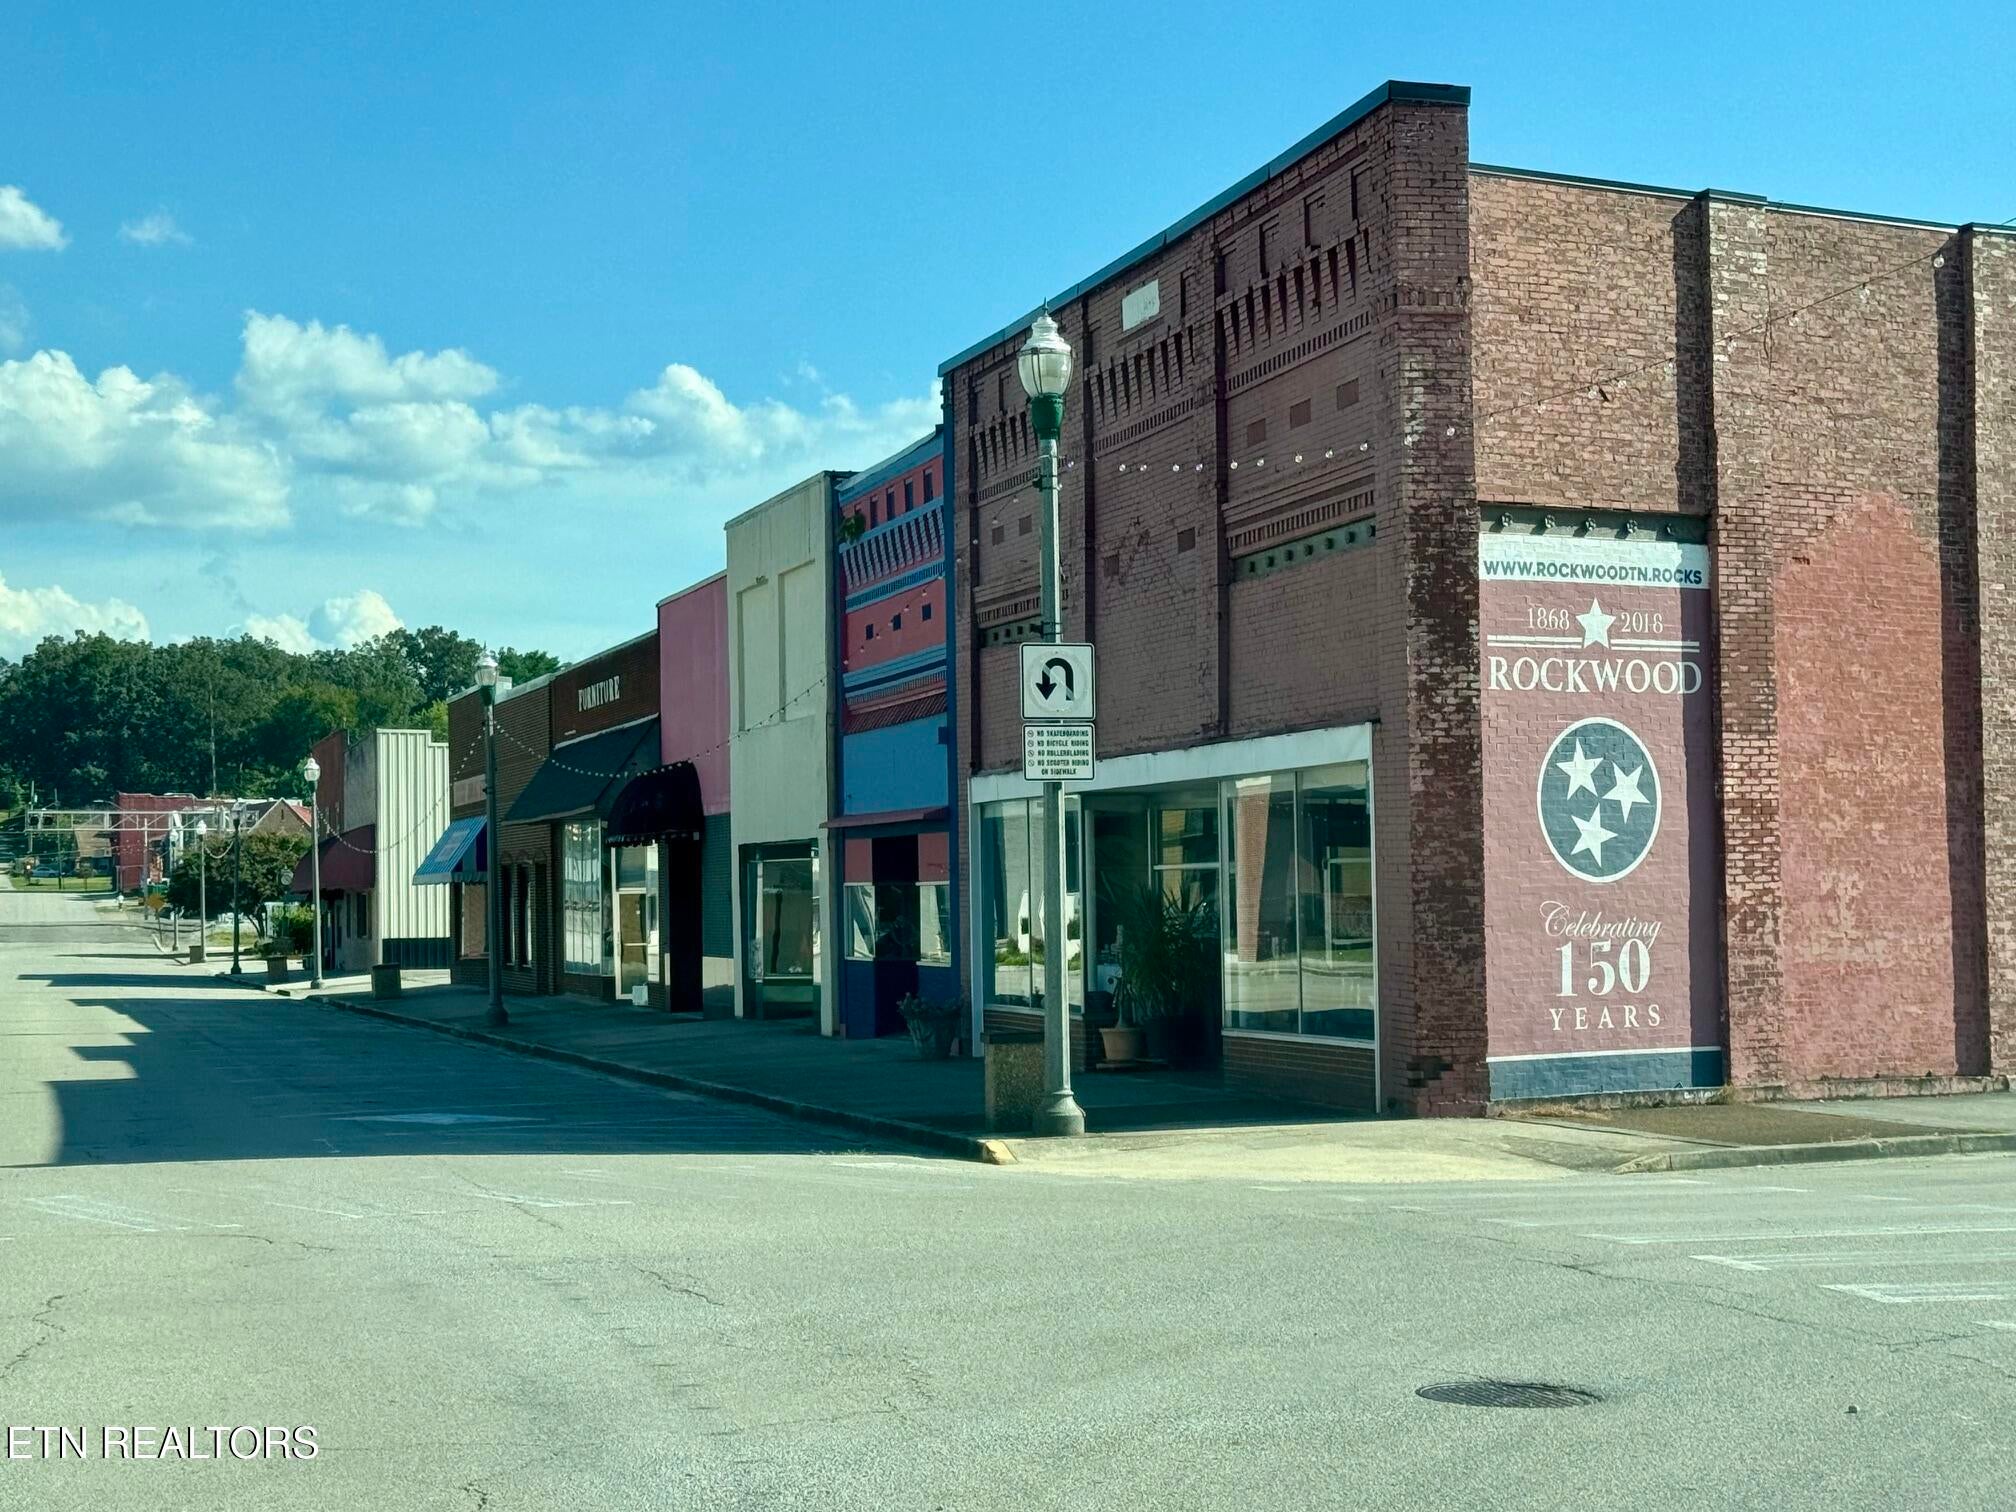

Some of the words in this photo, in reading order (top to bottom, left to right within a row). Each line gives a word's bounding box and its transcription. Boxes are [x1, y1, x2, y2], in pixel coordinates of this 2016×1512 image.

[1483, 560, 1702, 585] WWW.ROCKWOODTN.ROCKS
[1527, 607, 1570, 630] 1868
[1621, 611, 1663, 634] 2018
[578, 675, 620, 712] FURNITURE
[1487, 656, 1702, 695] ROCKWOOD
[1539, 900, 1662, 950] Celebrating
[1555, 938, 1650, 997] 150
[1549, 1004, 1661, 1031] YEARS
